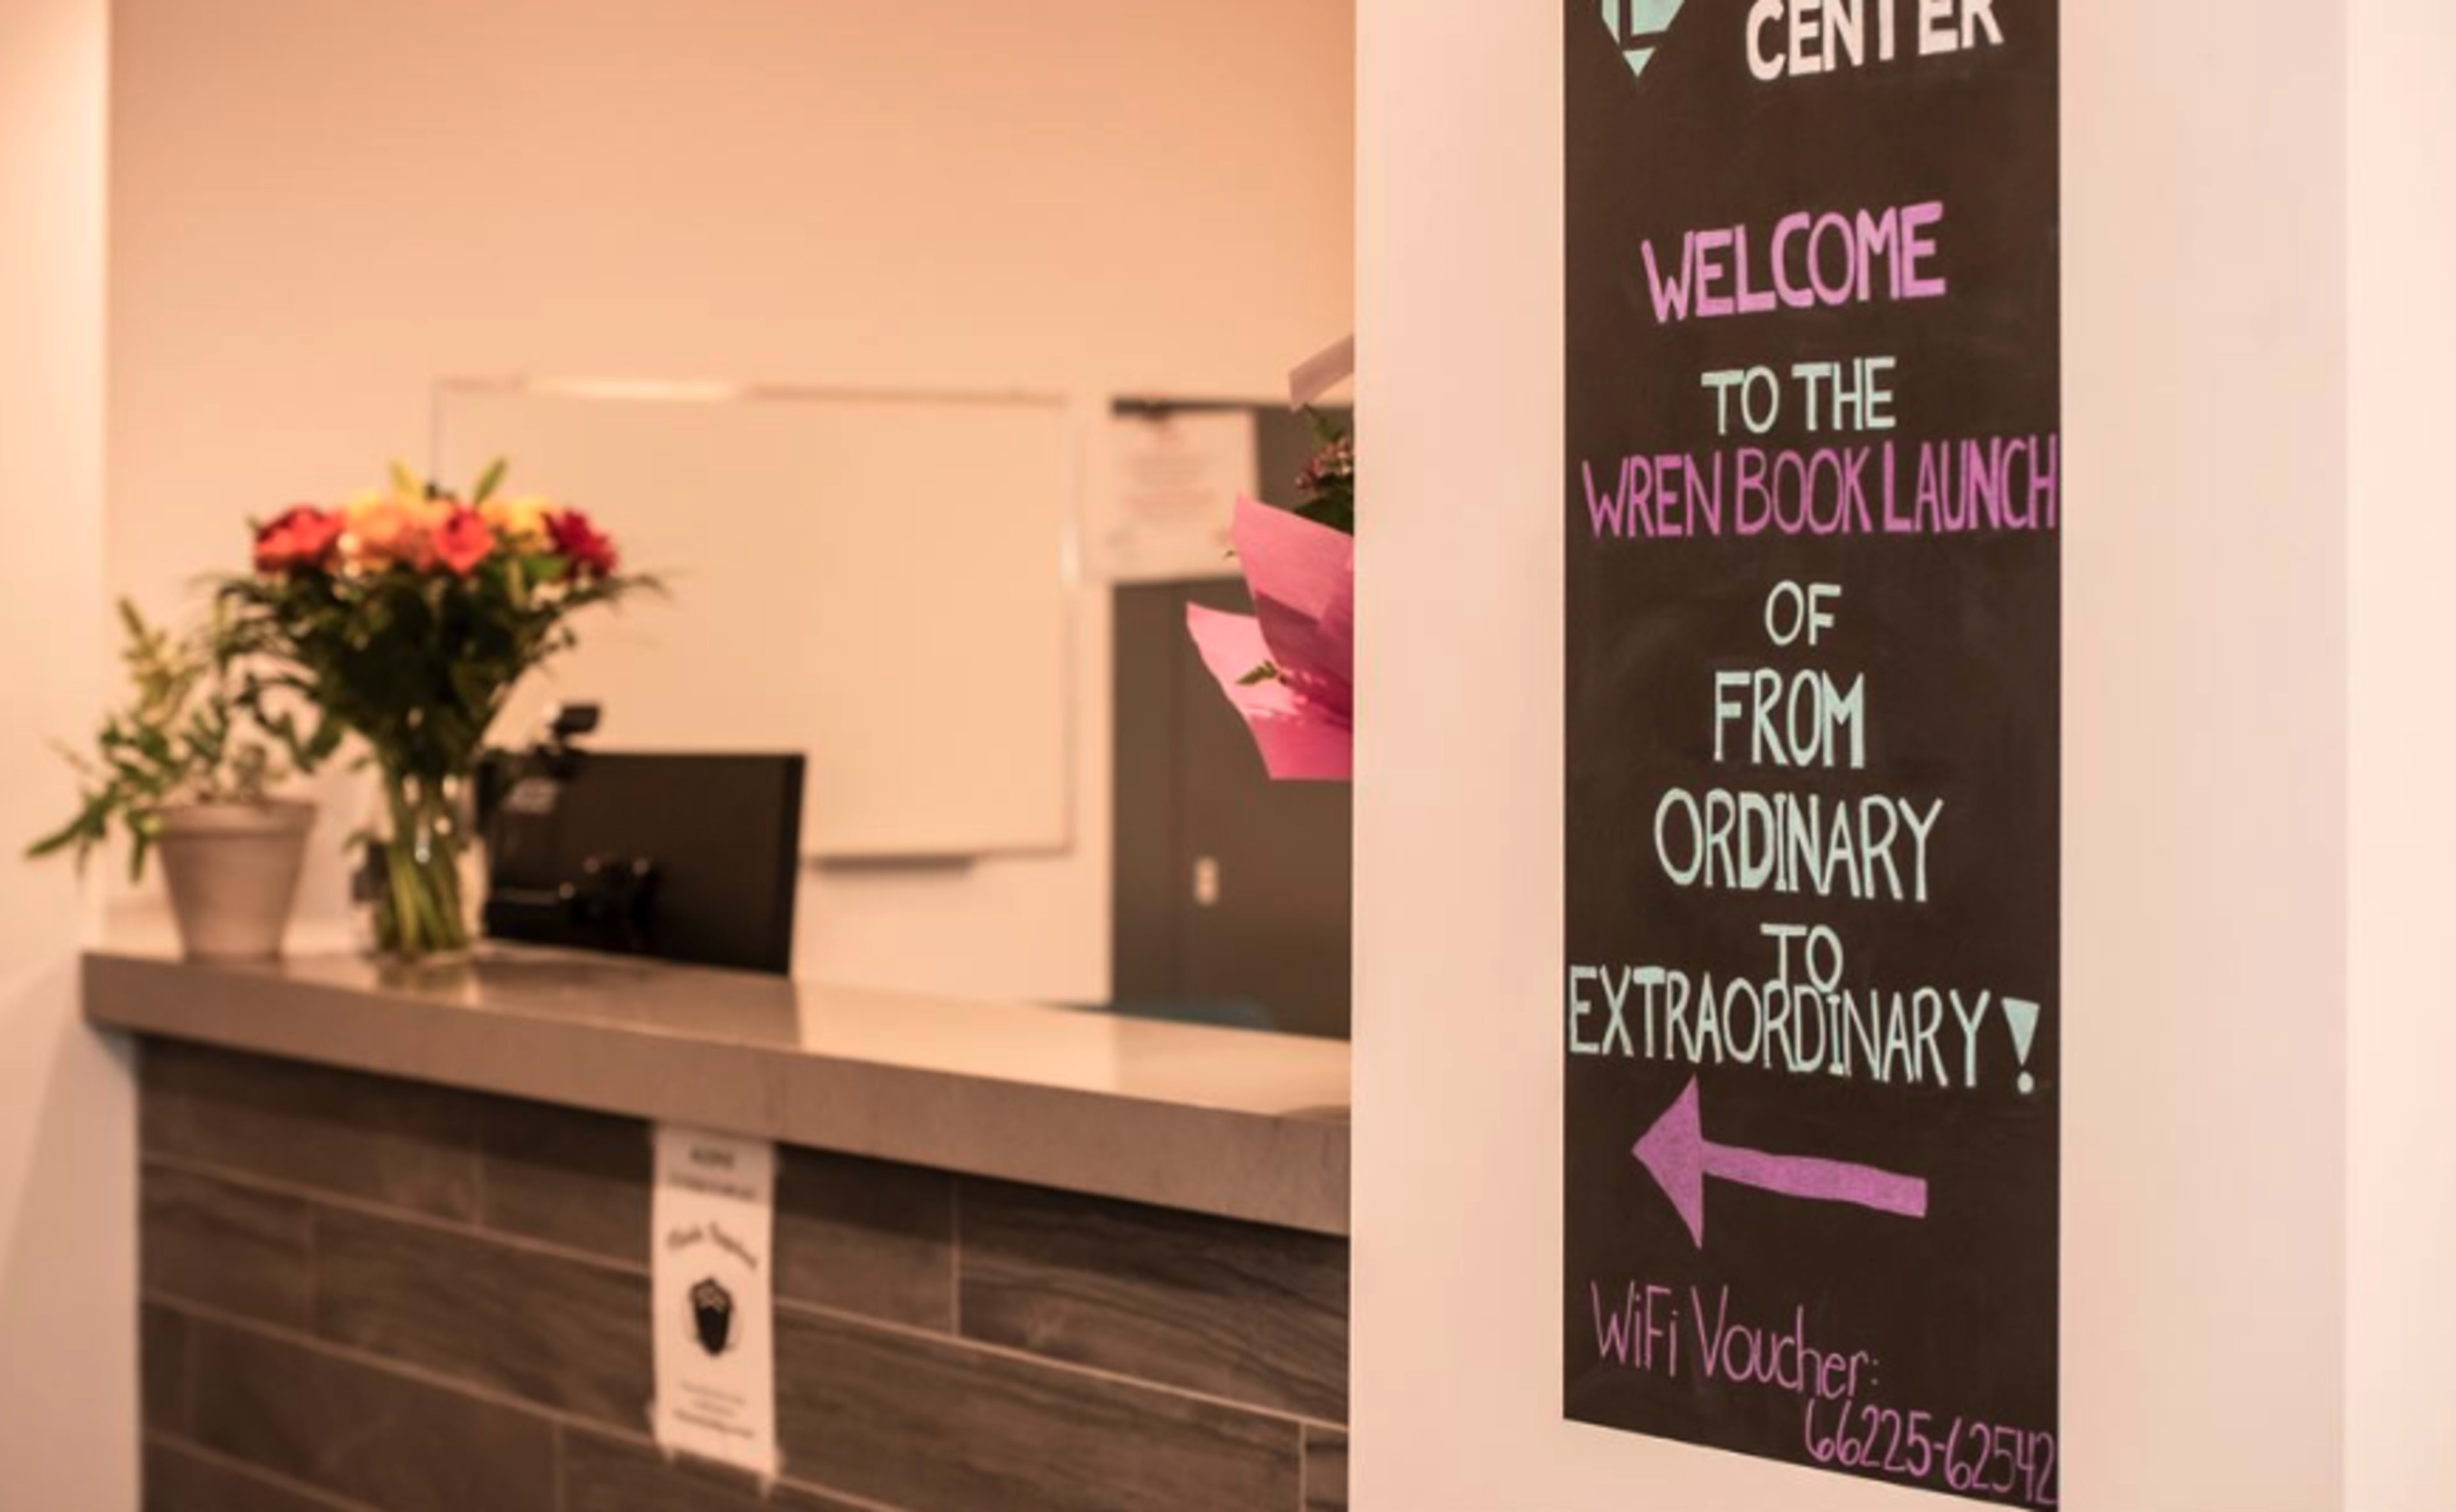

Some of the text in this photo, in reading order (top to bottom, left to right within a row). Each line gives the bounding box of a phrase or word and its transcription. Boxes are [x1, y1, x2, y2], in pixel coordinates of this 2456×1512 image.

[1641, 201, 1946, 323] WELCOME
[1701, 356, 1896, 435] TO THE
[1582, 434, 2058, 537] WREN BOOK LAUNCH
[1765, 580, 1841, 645] OF
[1714, 668, 1864, 768] FROM
[1654, 787, 1944, 902] ORDINARY
[1760, 923, 1843, 993] TO
[1591, 1280, 1880, 1399] WiFi Voucher:
[1804, 1398, 2058, 1506] 66225-62542
